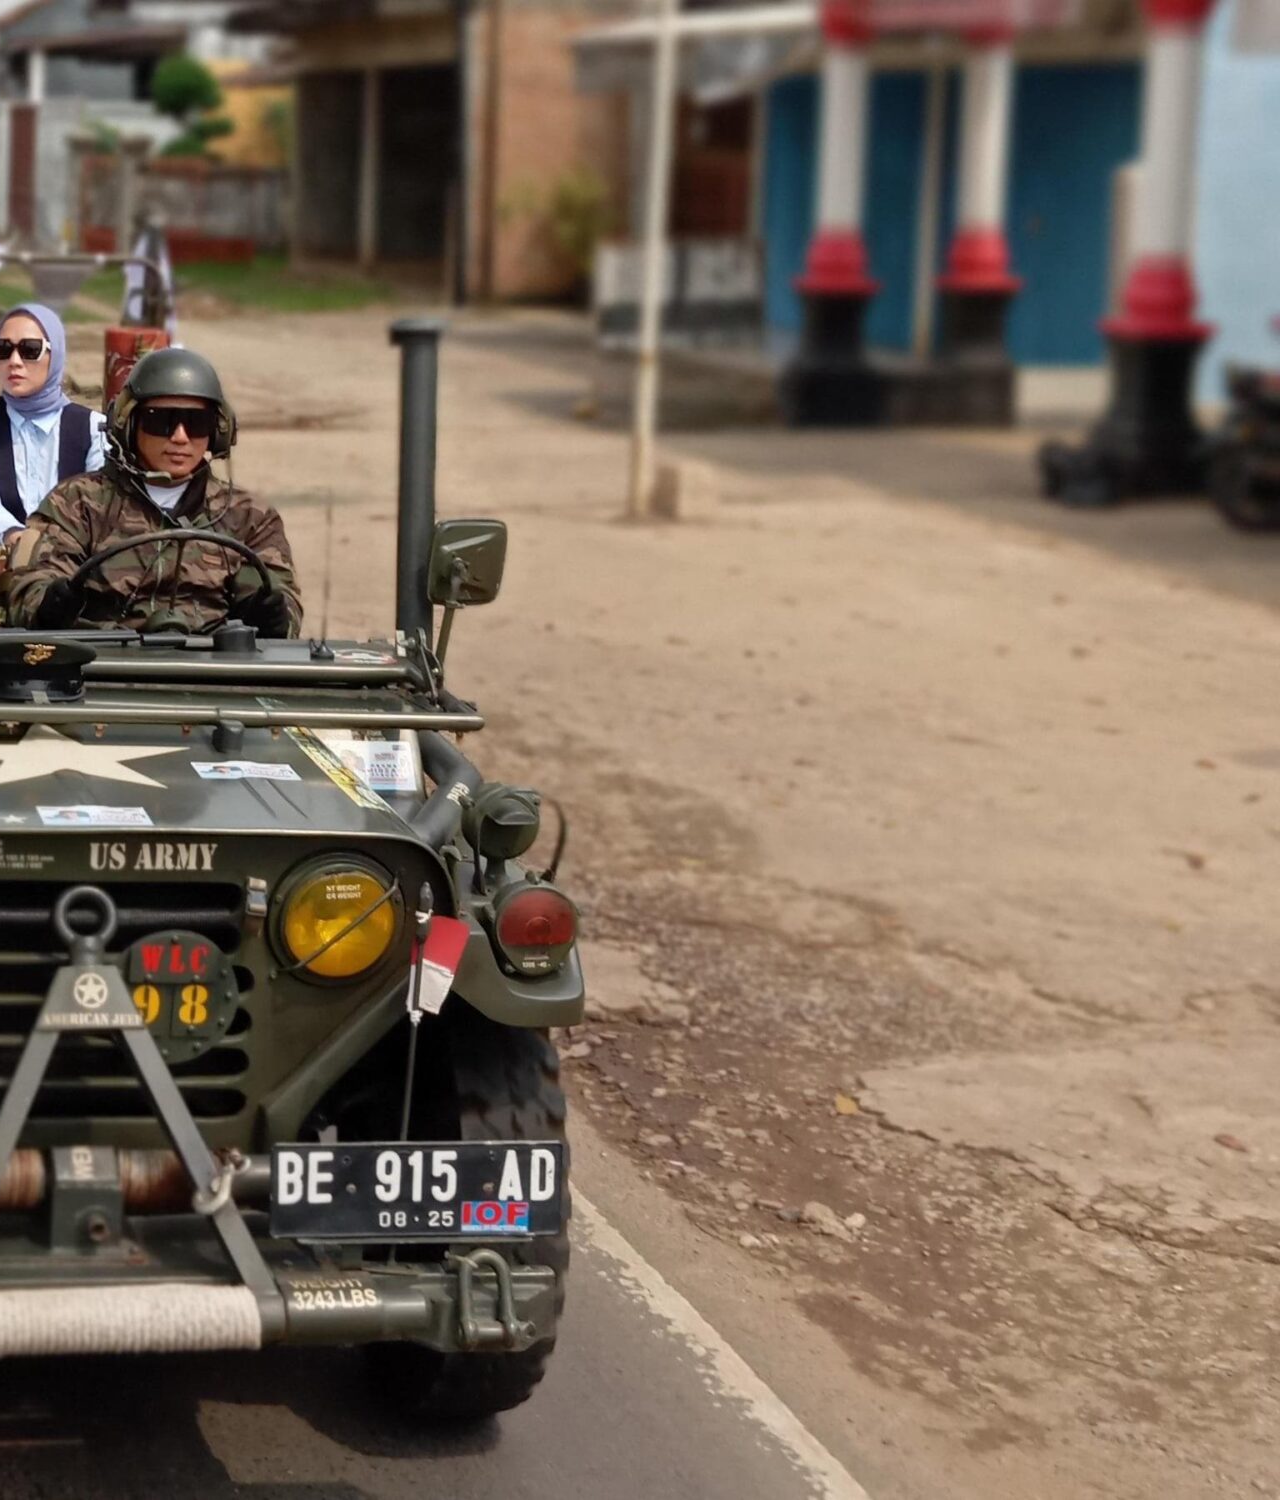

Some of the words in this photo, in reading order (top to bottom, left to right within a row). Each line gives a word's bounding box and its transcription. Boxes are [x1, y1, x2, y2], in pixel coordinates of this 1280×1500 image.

[89, 842, 126, 870] US
[133, 842, 218, 871] ARMY
[141, 944, 209, 974] WLC
[132, 983, 209, 1025] 98
[43, 1012, 109, 1025] AMERICAN
[277, 1151, 334, 1204] BE
[375, 1150, 458, 1203] 915
[497, 1149, 556, 1202] AD
[379, 1211, 407, 1228] 08
[428, 1210, 455, 1227] 25
[461, 1201, 529, 1226] IOF
[293, 1289, 336, 1311] 3243
[339, 1287, 378, 1309] LBS
